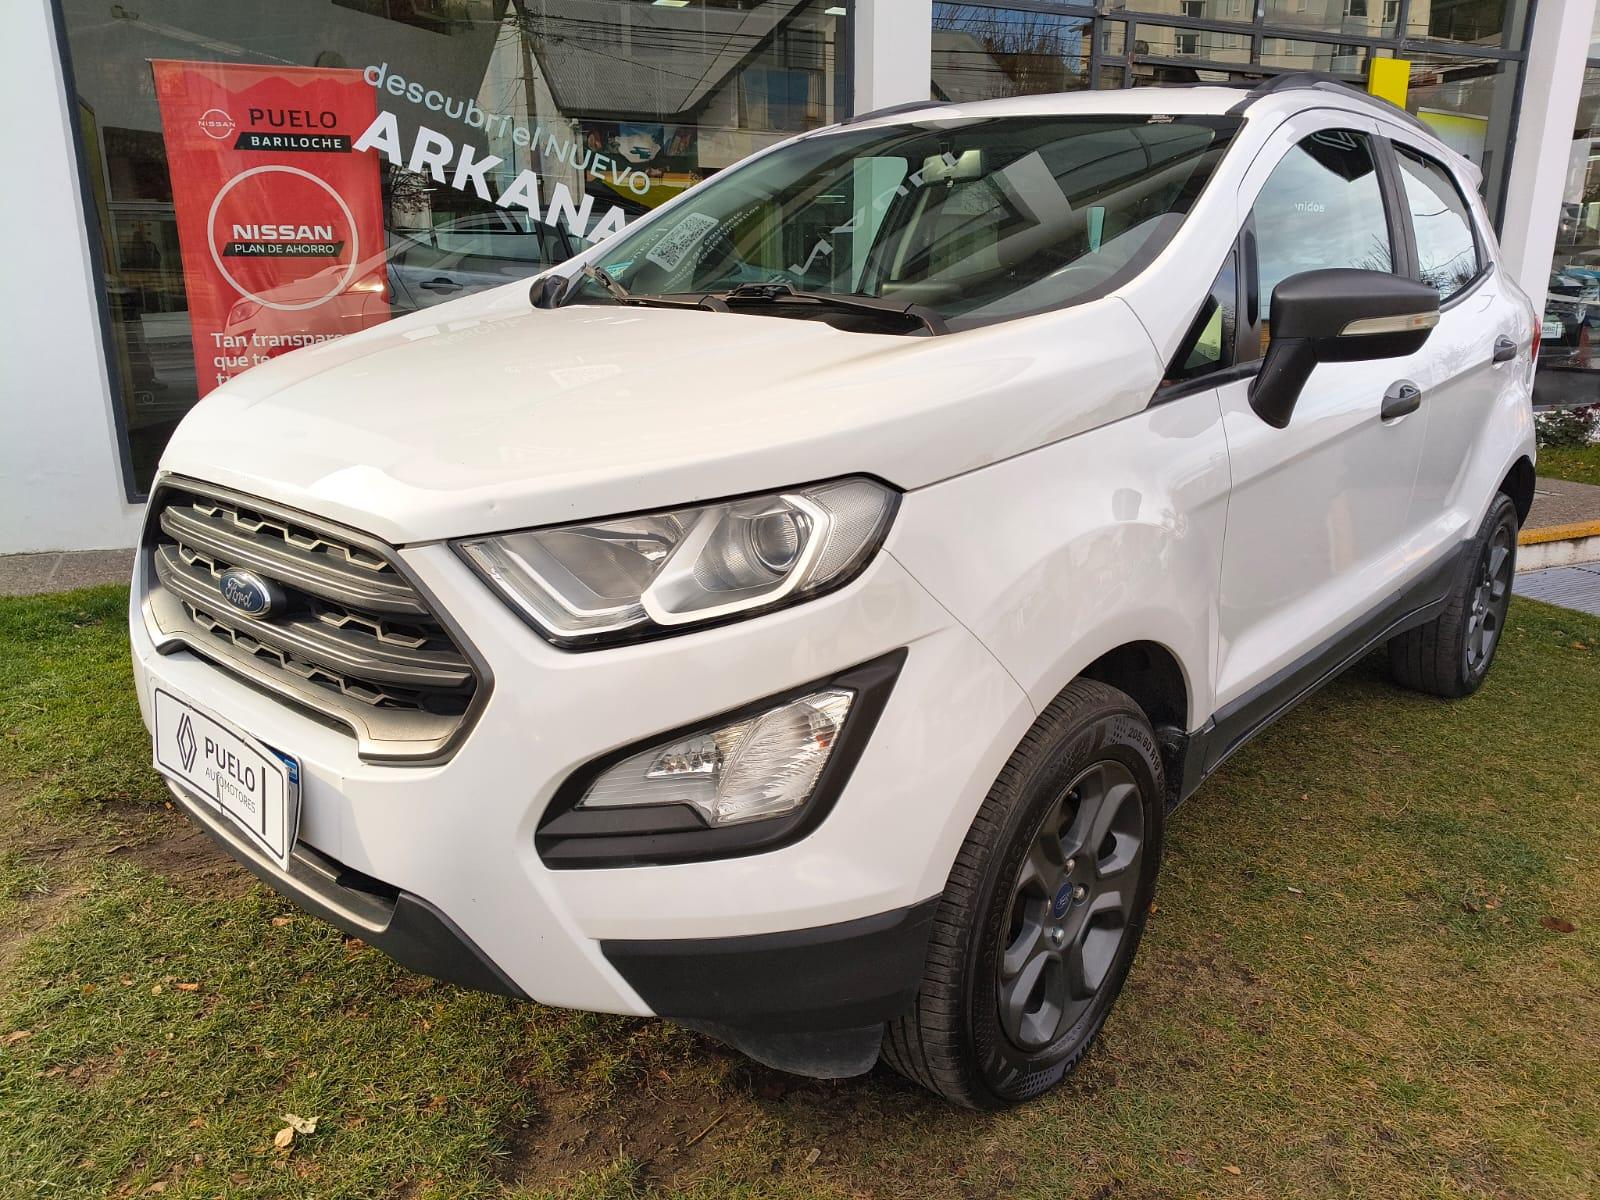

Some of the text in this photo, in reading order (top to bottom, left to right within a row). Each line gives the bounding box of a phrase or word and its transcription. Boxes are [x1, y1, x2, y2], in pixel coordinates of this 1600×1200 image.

[198, 120, 236, 128] NISSAN
[248, 108, 337, 129] PUELO
[251, 136, 342, 149] BARILOCHE
[512, 123, 542, 151] el
[544, 133, 651, 195] NUEVO
[352, 110, 627, 244] ARKANA
[232, 224, 333, 241] NISSAN
[234, 244, 335, 254] PLAN DE AHORRO
[210, 332, 251, 348] Tan
[213, 355, 249, 371] que
[224, 577, 254, 608] Ford
[204, 736, 256, 792] PUELO
